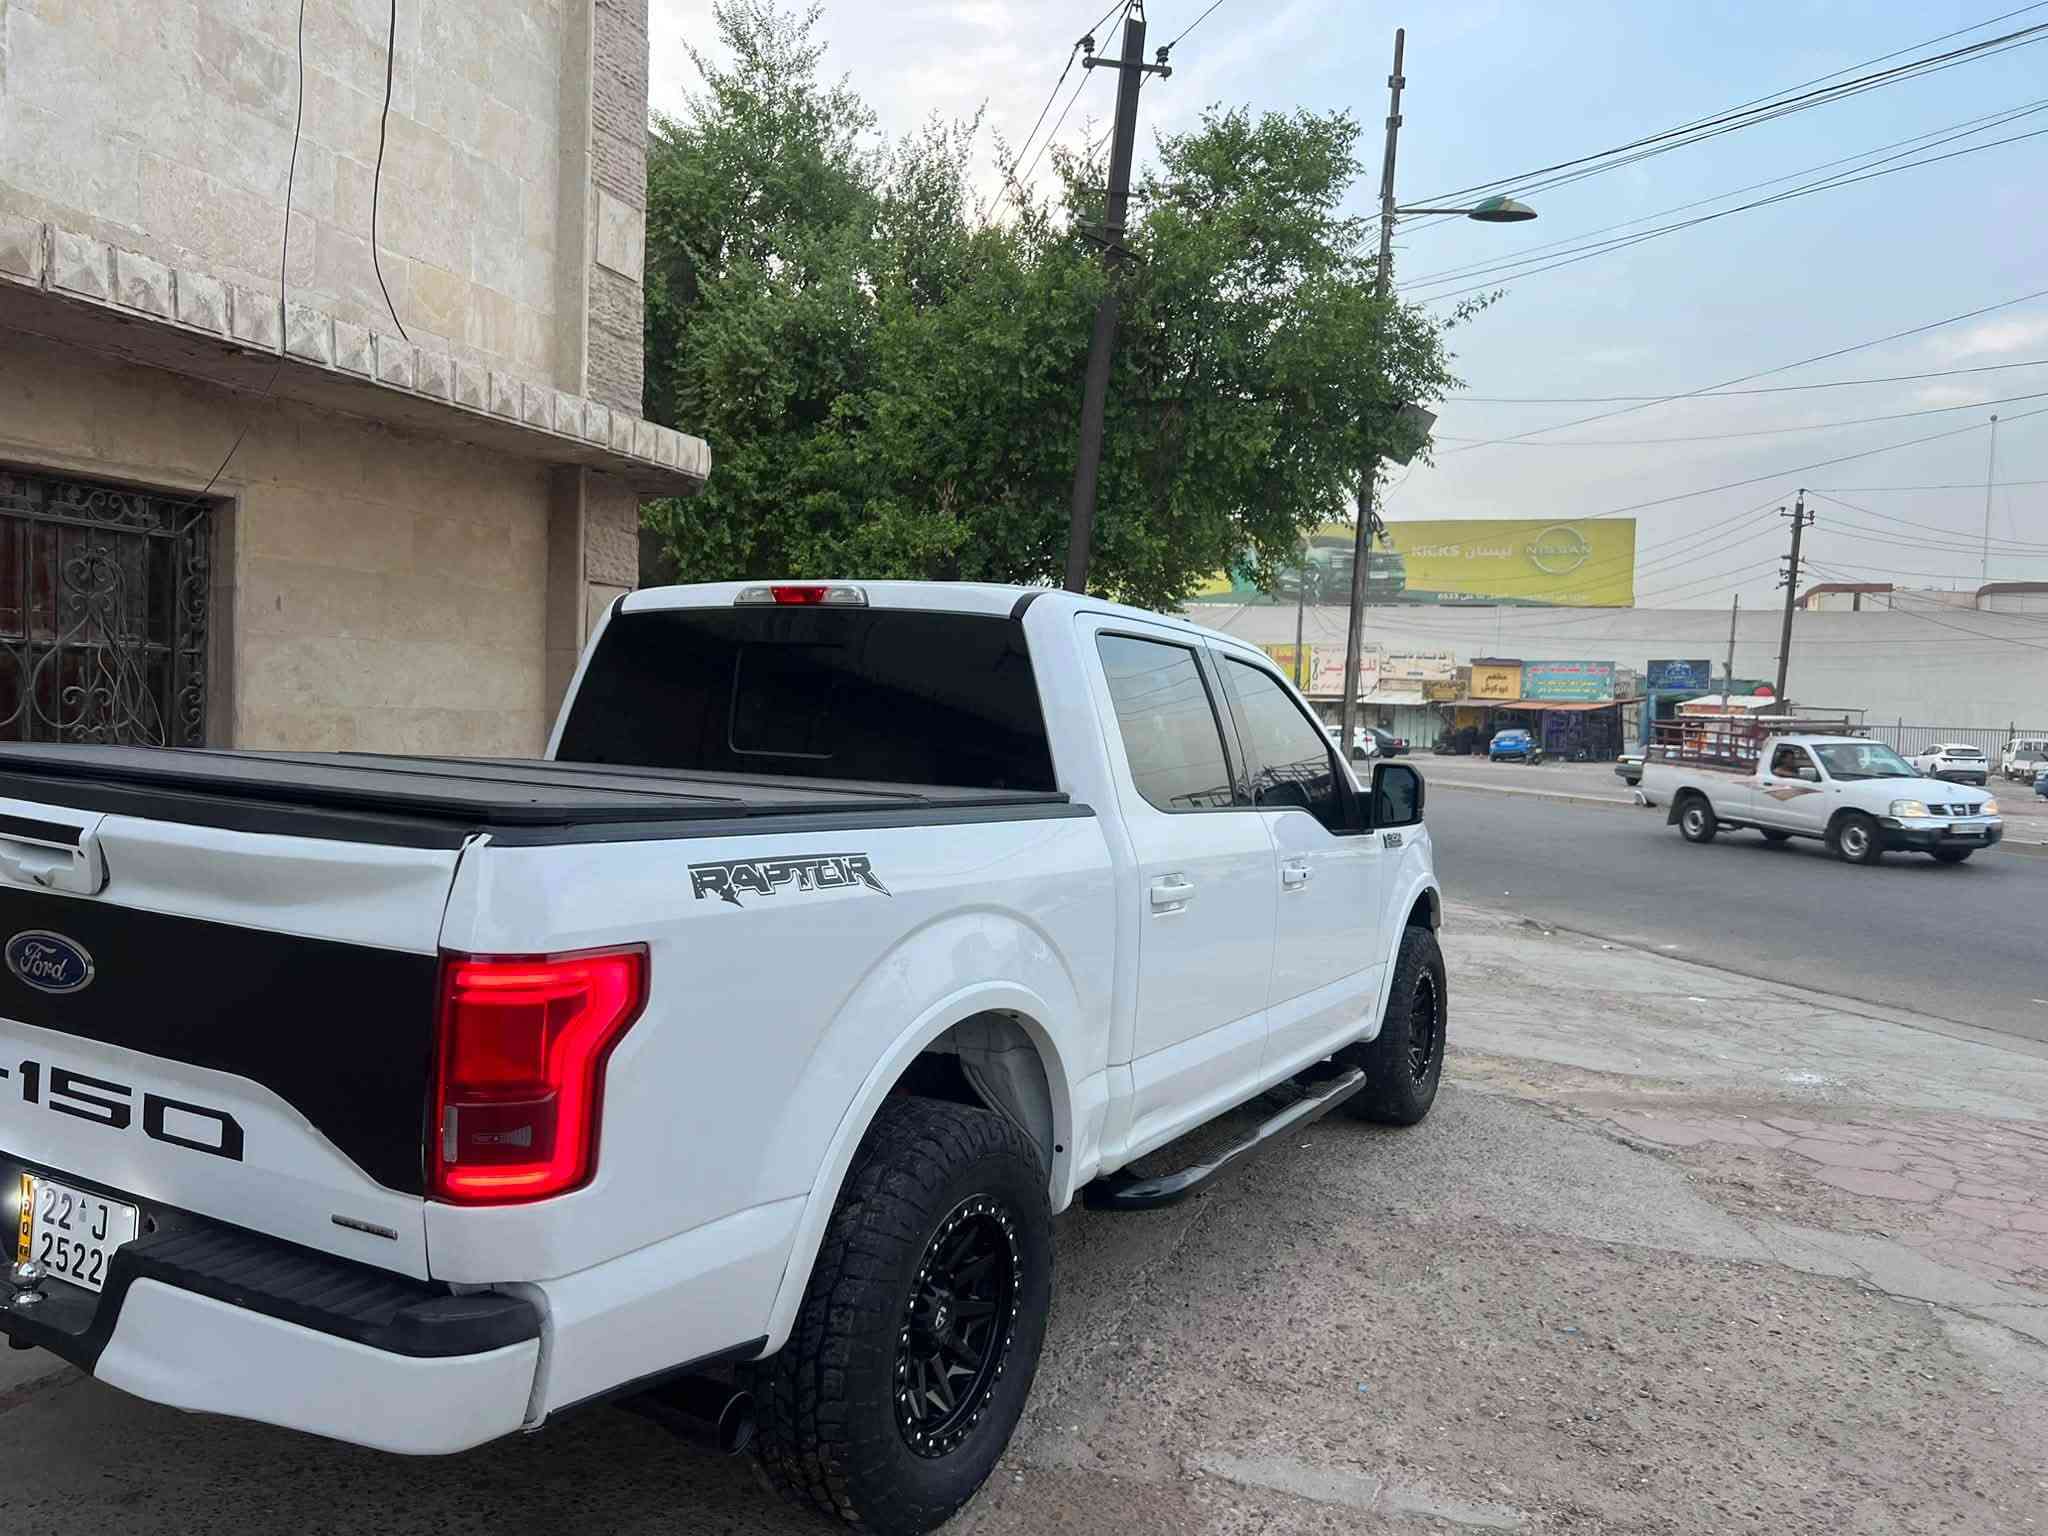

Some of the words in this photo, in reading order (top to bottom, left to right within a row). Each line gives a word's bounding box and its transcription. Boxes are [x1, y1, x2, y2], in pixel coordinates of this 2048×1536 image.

[1411, 544, 1460, 558] KICKS
[1526, 543, 1592, 555] NISSAN
[688, 853, 892, 908] RAPTOR
[20, 942, 66, 981] Ford
[42, 1188, 72, 1230] 22
[92, 1204, 108, 1241] J
[40, 1231, 112, 1286] 2522
